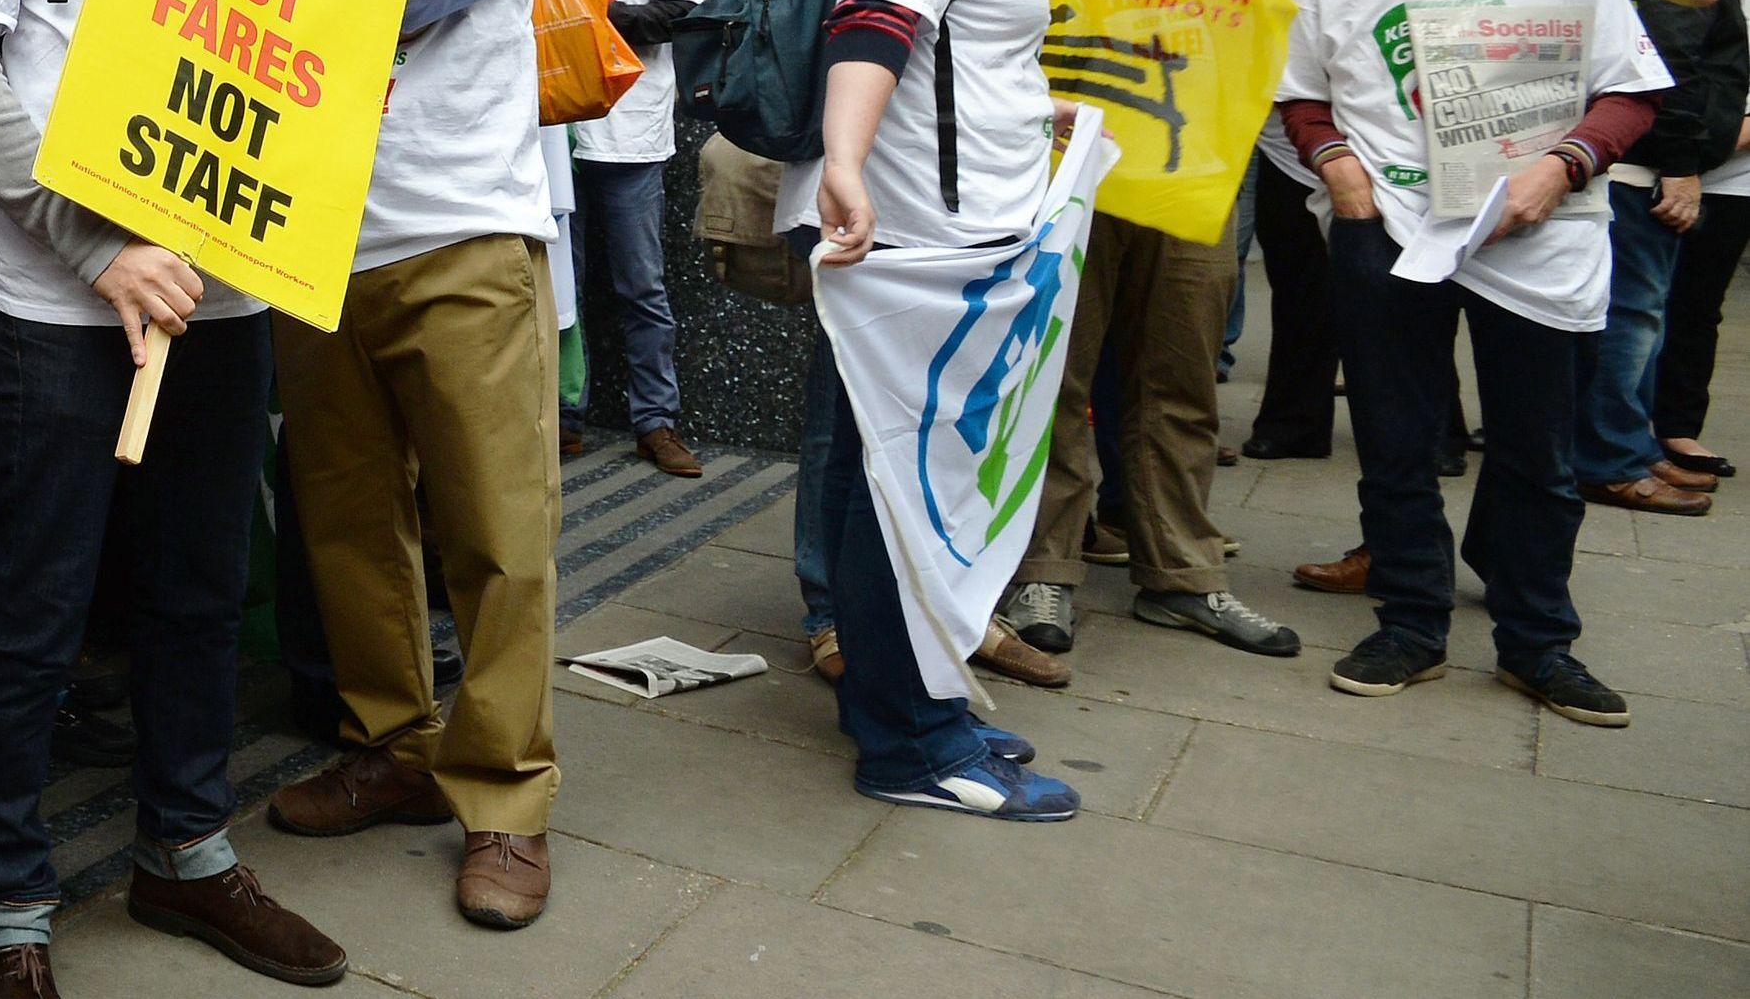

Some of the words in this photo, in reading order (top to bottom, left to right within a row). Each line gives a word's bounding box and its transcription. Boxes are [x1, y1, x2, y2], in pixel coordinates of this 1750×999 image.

[1477, 19, 1583, 38] Socialist
[167, 56, 281, 162] NOT
[1434, 73, 1578, 127] COMPROMISE
[1436, 125, 1487, 148] WITH
[119, 114, 293, 243] STAFF
[71, 159, 111, 184] National
[112, 180, 139, 199] Union
[140, 195, 151, 205] of
[173, 212, 211, 239] Maritime
[212, 235, 228, 249] and
[230, 245, 274, 274] Transport
[275, 268, 316, 291] Workers
